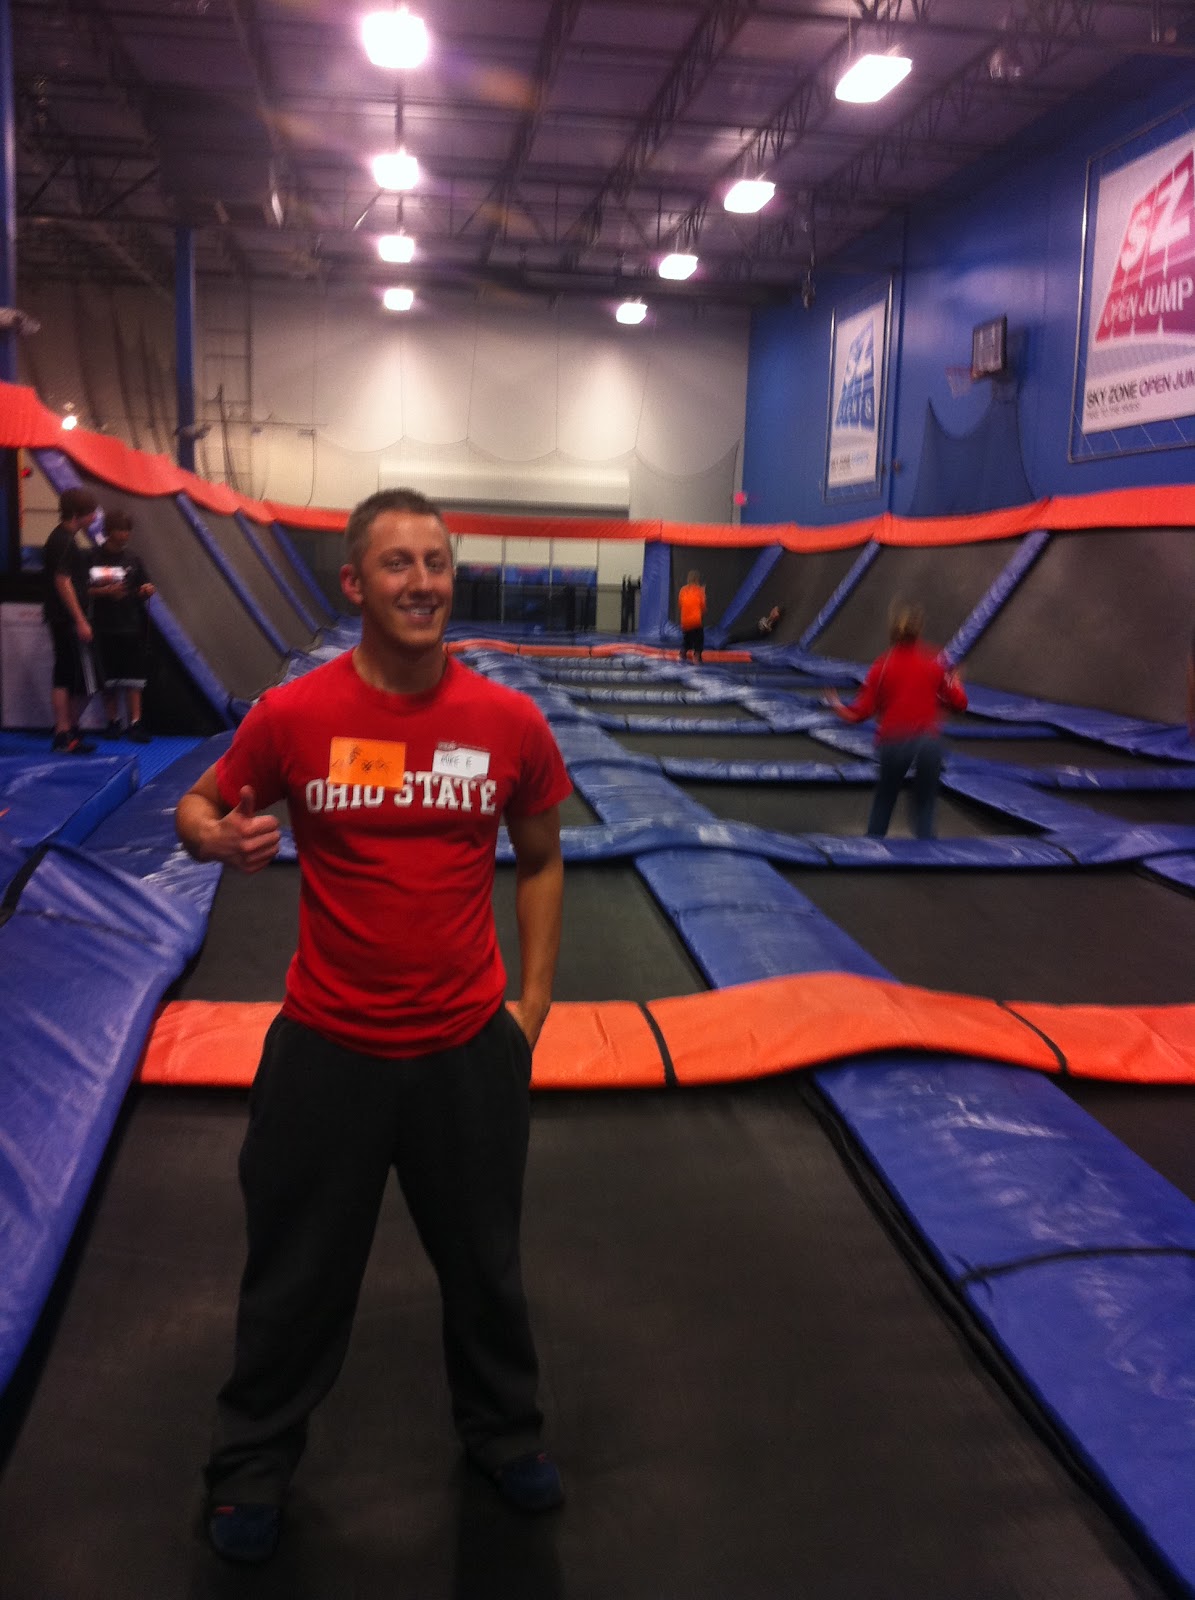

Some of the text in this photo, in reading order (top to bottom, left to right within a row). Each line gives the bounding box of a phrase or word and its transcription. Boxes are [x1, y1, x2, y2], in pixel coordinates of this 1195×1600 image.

[1104, 276, 1194, 328] OPEN JUMP
[1086, 387, 1106, 409] SKY
[1107, 381, 1138, 404] ZONE
[1139, 374, 1171, 397] OPEN
[305, 771, 497, 816] OHIO STATE
